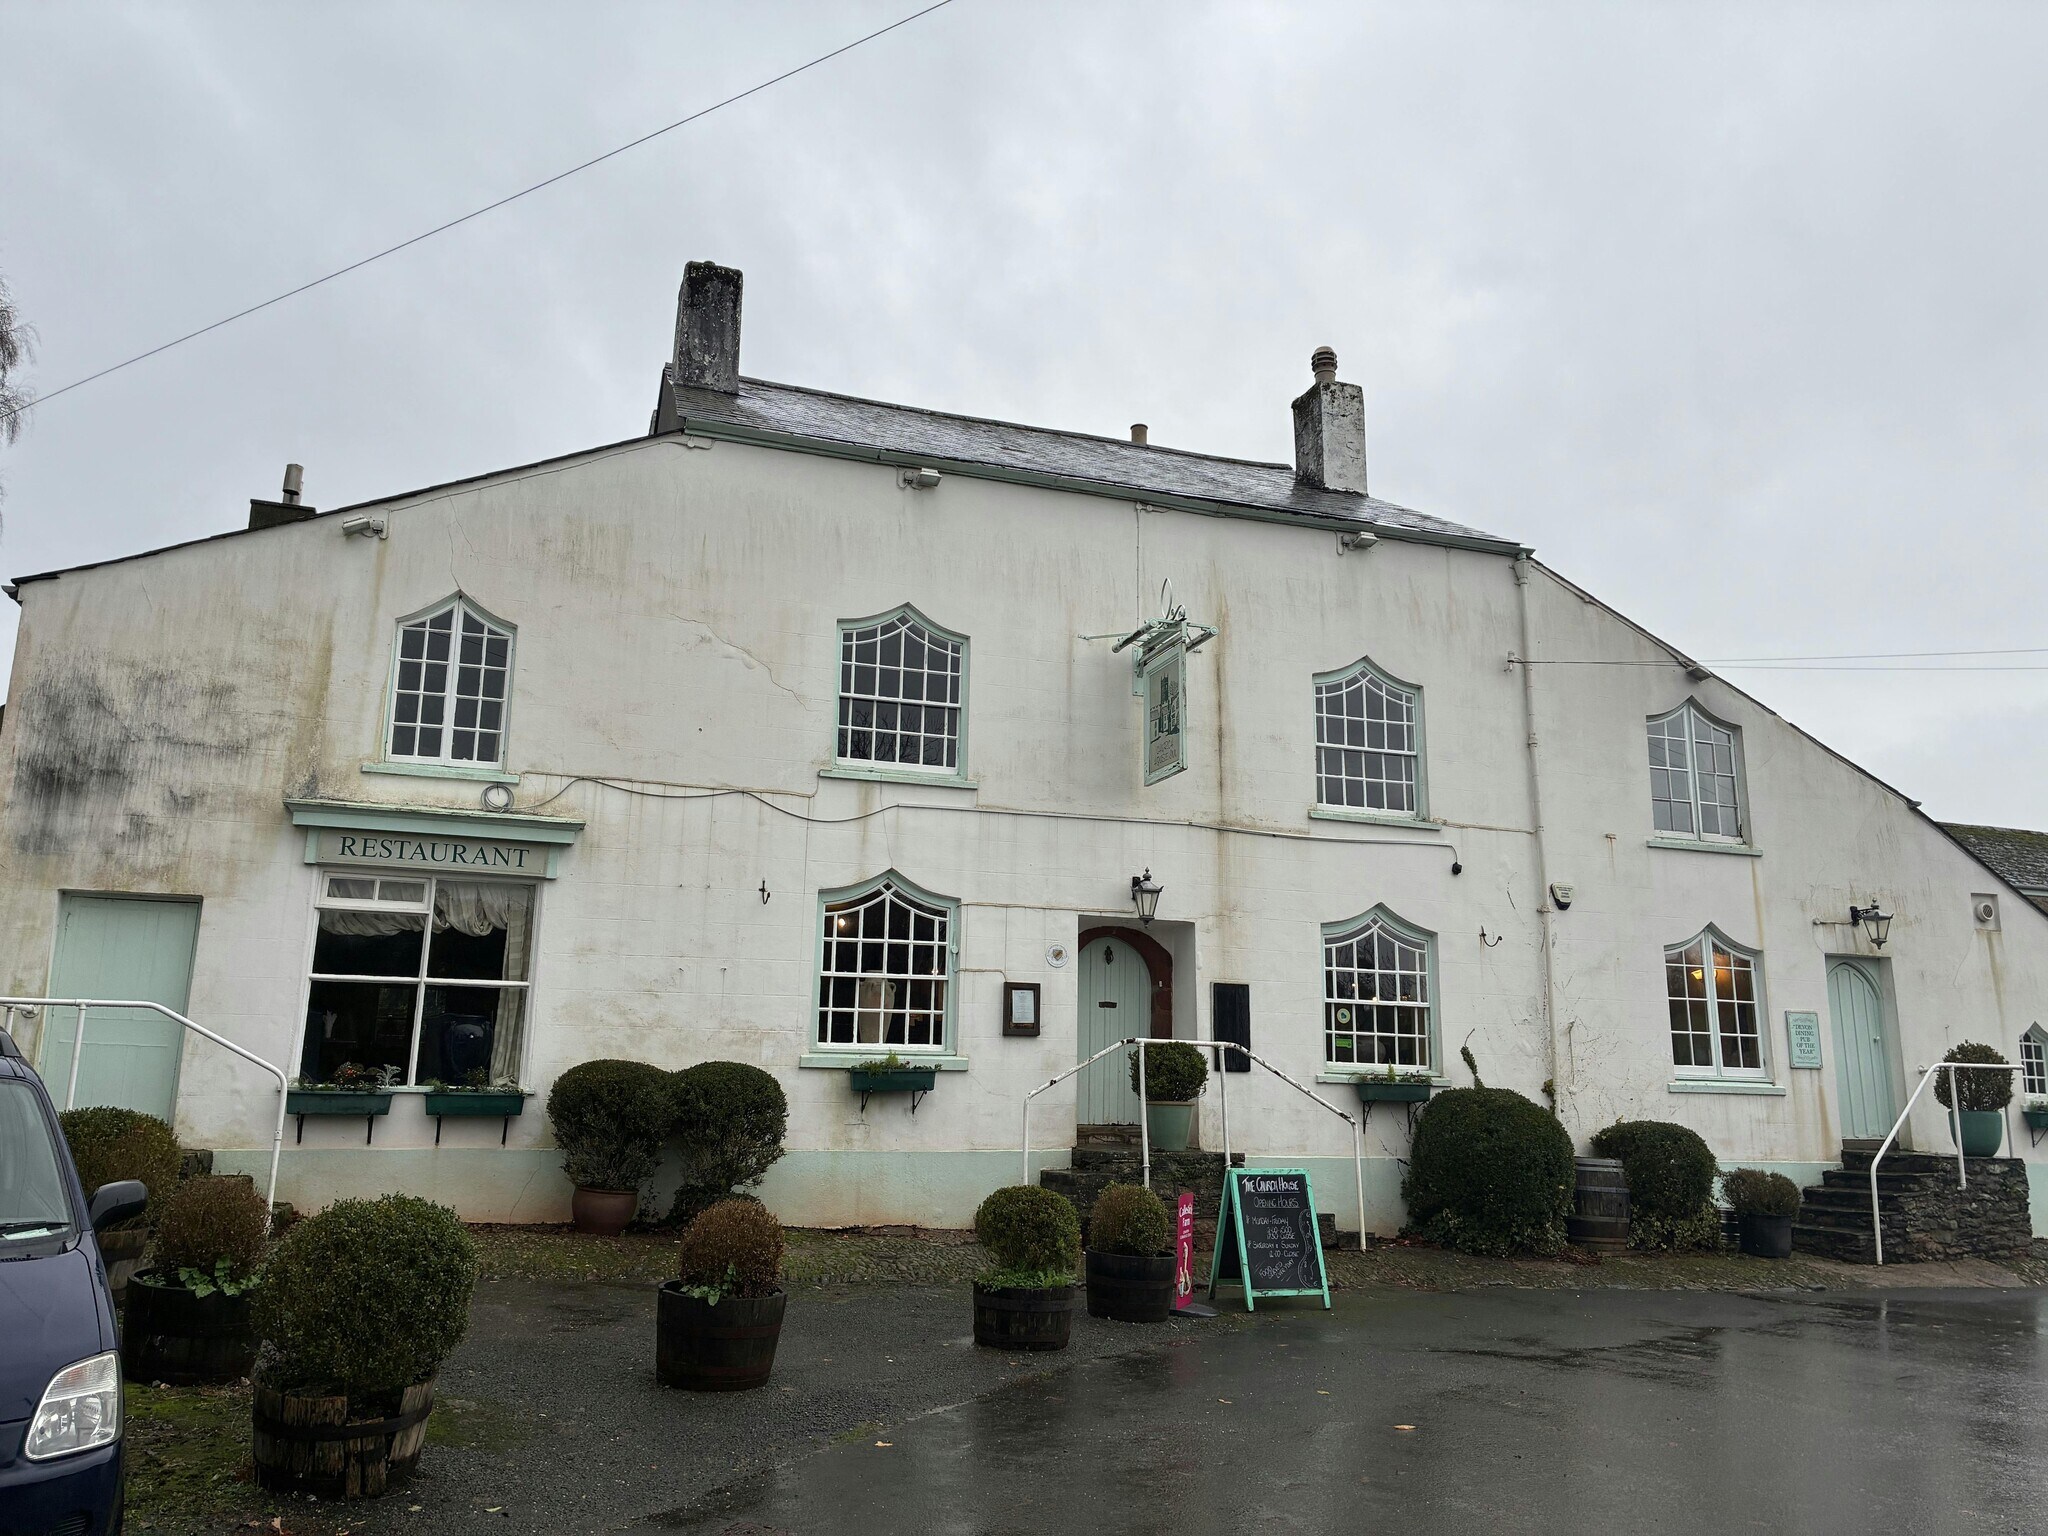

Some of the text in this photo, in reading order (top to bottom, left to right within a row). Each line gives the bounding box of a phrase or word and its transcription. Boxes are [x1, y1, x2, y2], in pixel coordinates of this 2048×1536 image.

[339, 836, 530, 868] RESTAURANT
[1241, 1176, 1299, 1193] THE CHURCH HOUSE
[1253, 1195, 1299, 1208] OPENING HOURS
